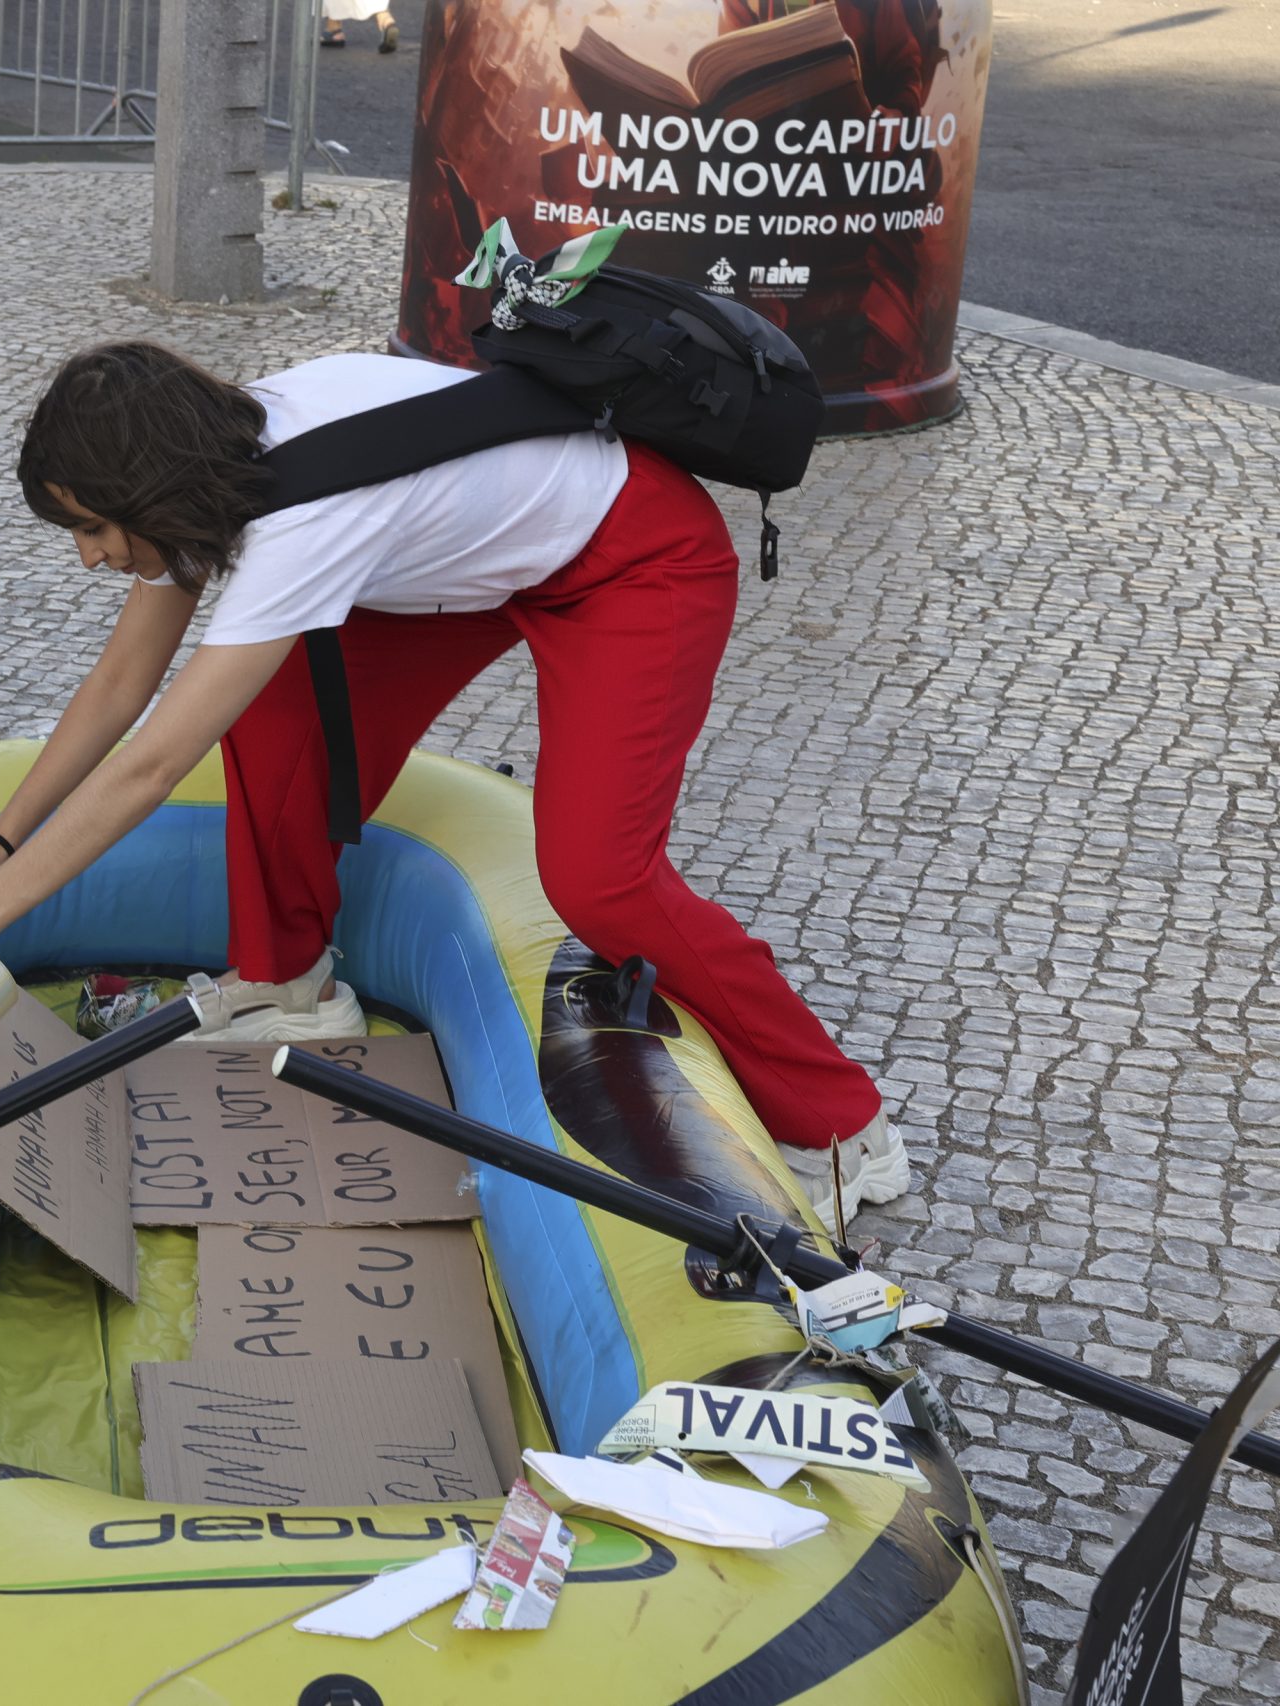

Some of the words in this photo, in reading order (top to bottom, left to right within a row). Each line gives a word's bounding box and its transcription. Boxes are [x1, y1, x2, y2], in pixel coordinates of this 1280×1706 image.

[538, 106, 604, 147] UM
[618, 113, 759, 154] NOVO
[774, 108, 958, 156] CAPÍTULO
[576, 153, 680, 195] UMA
[697, 160, 827, 198] NOVA
[844, 158, 926, 195] VIDA
[533, 201, 707, 235] EMBALAGENS
[714, 213, 751, 236] DE
[757, 214, 837, 236] VIDRO
[843, 213, 877, 235] NO
[881, 204, 945, 233] VIDRÃO
[704, 285, 736, 295] ISBOA
[206, 1050, 262, 1074] IN
[128, 1088, 192, 1122] AT
[217, 1085, 284, 1129] NOT
[130, 1134, 213, 1208] LOST
[234, 1139, 309, 1207] SEA,
[334, 1147, 397, 1202] OUR
[346, 1246, 415, 1310] EU
[88, 1511, 495, 1550] debut
